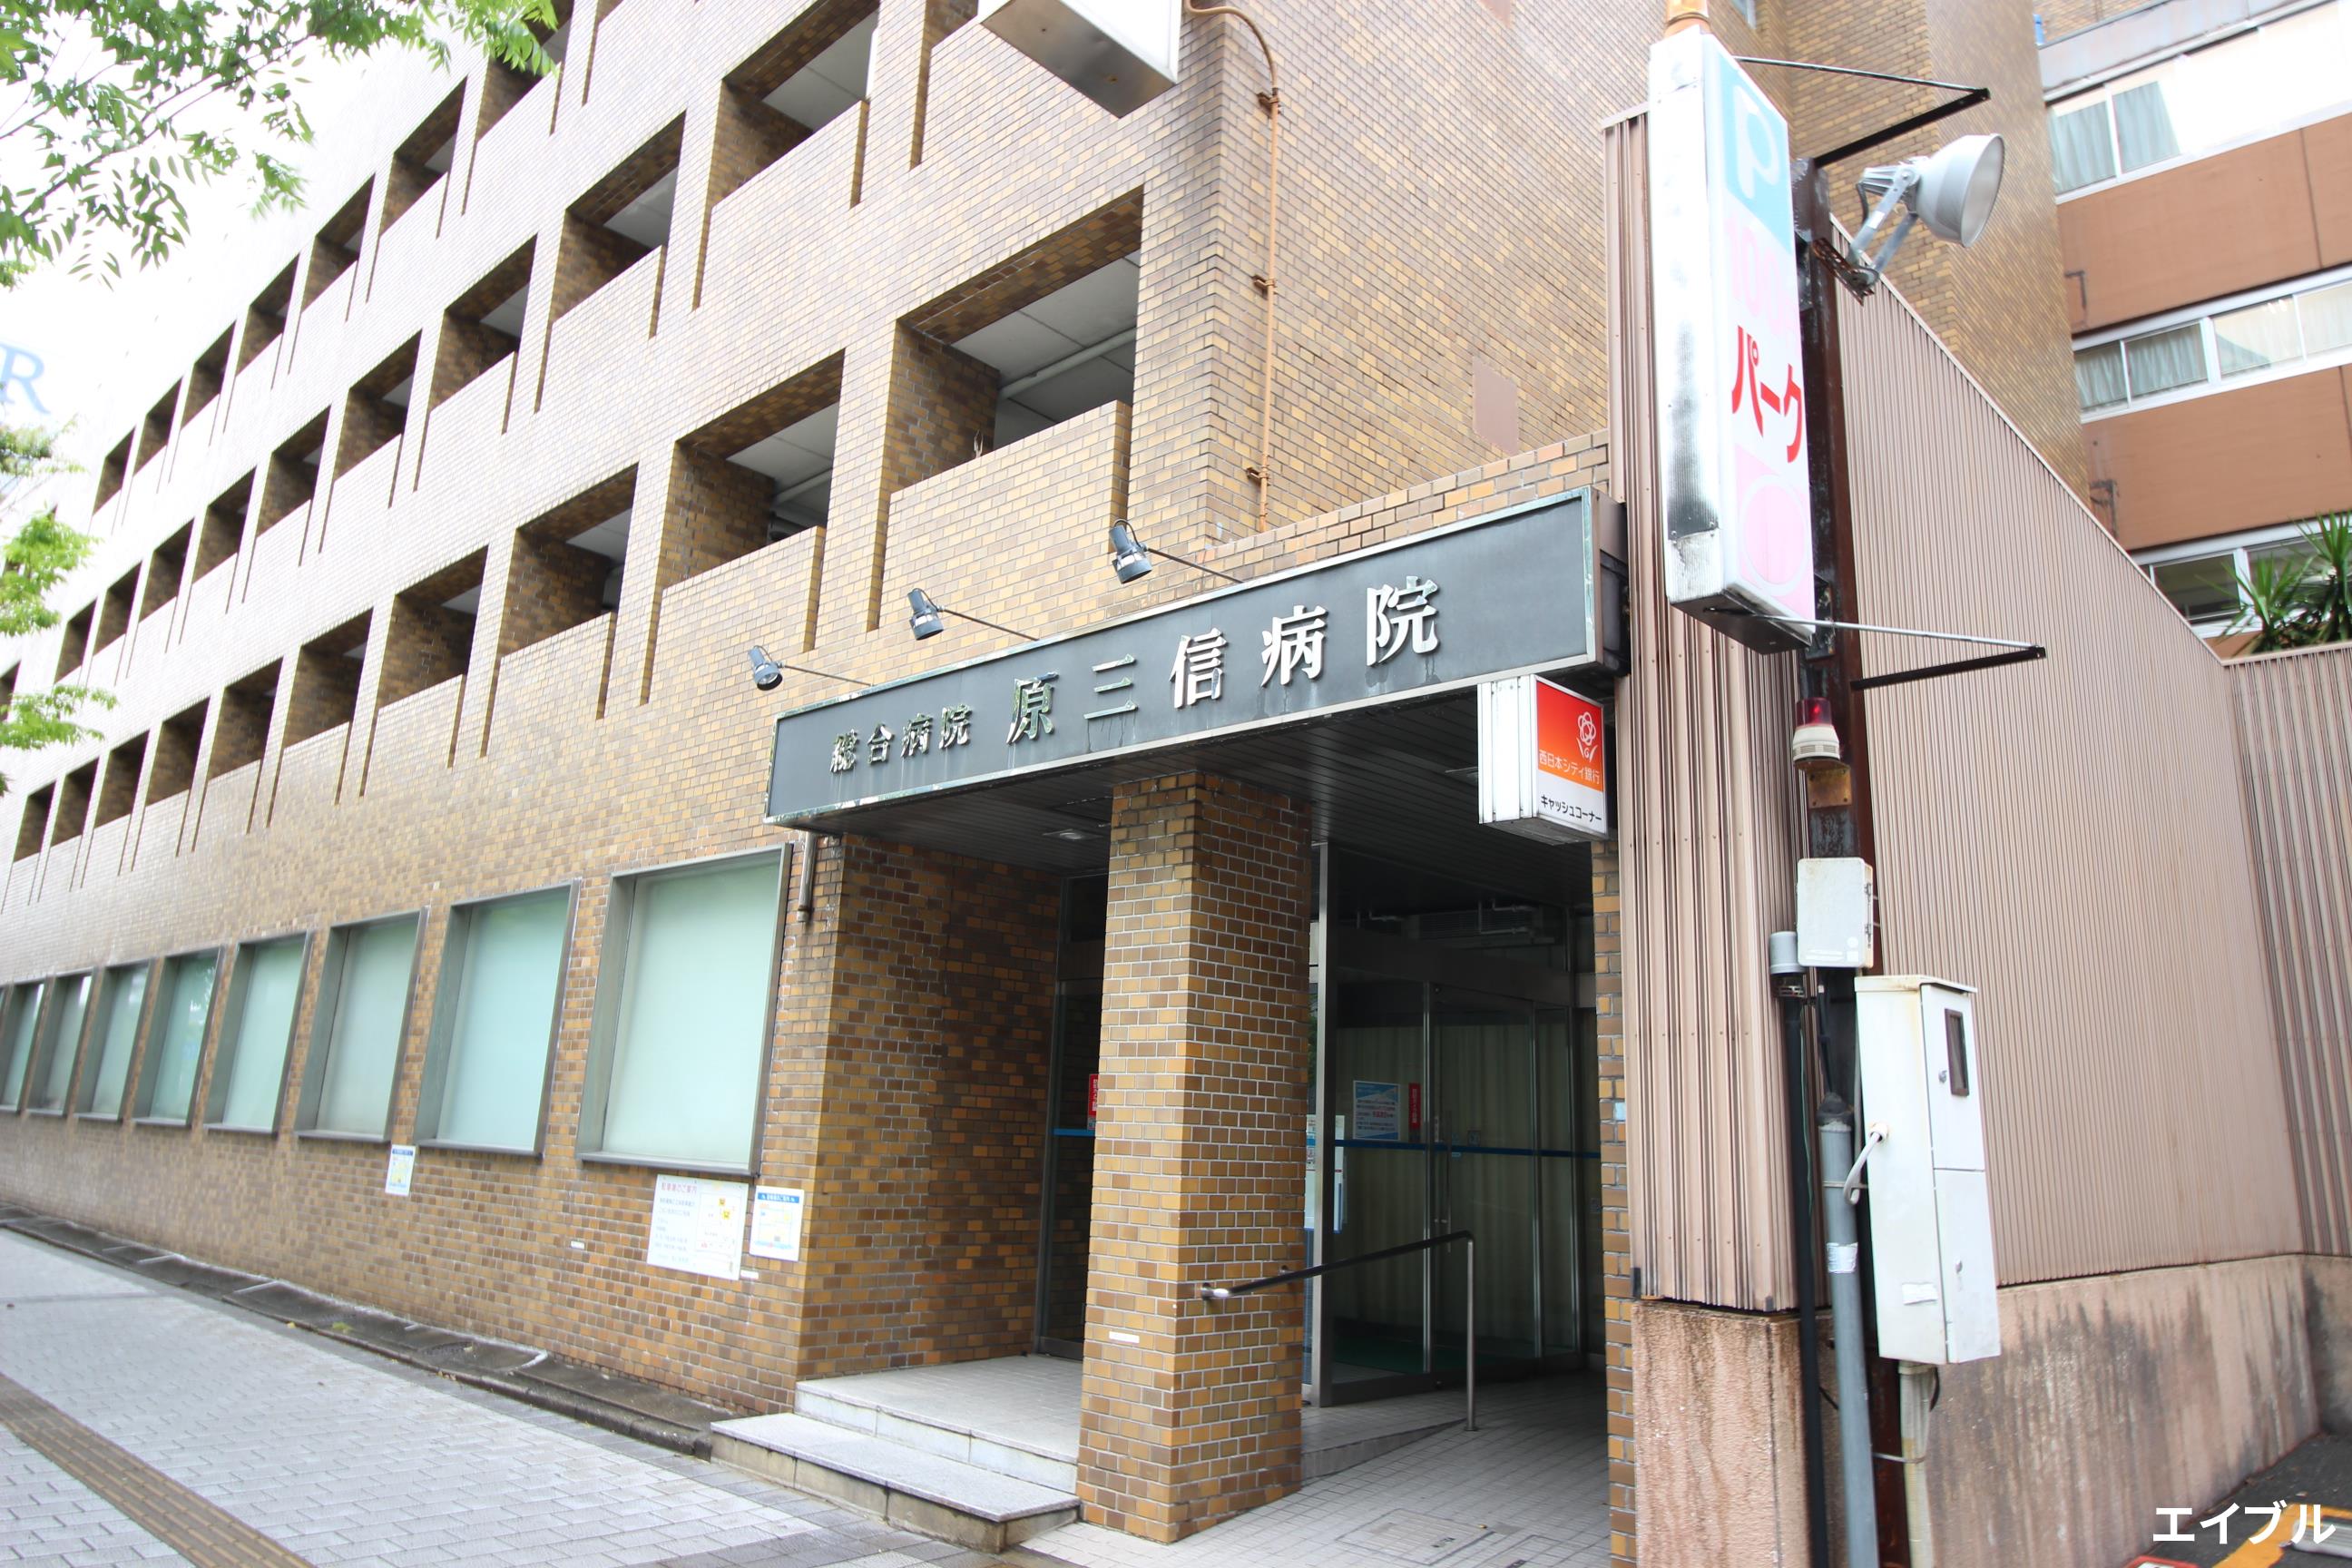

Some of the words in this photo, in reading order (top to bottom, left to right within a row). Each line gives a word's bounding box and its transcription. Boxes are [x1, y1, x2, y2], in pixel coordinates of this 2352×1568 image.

[1735, 83, 1779, 200] P
[1731, 325, 1802, 465] パーク
[1006, 574, 1440, 745] 原三信病院
[1539, 750, 1601, 785] 西日本シティ銀行
[1541, 794, 1602, 823] キャッシュコーナー
